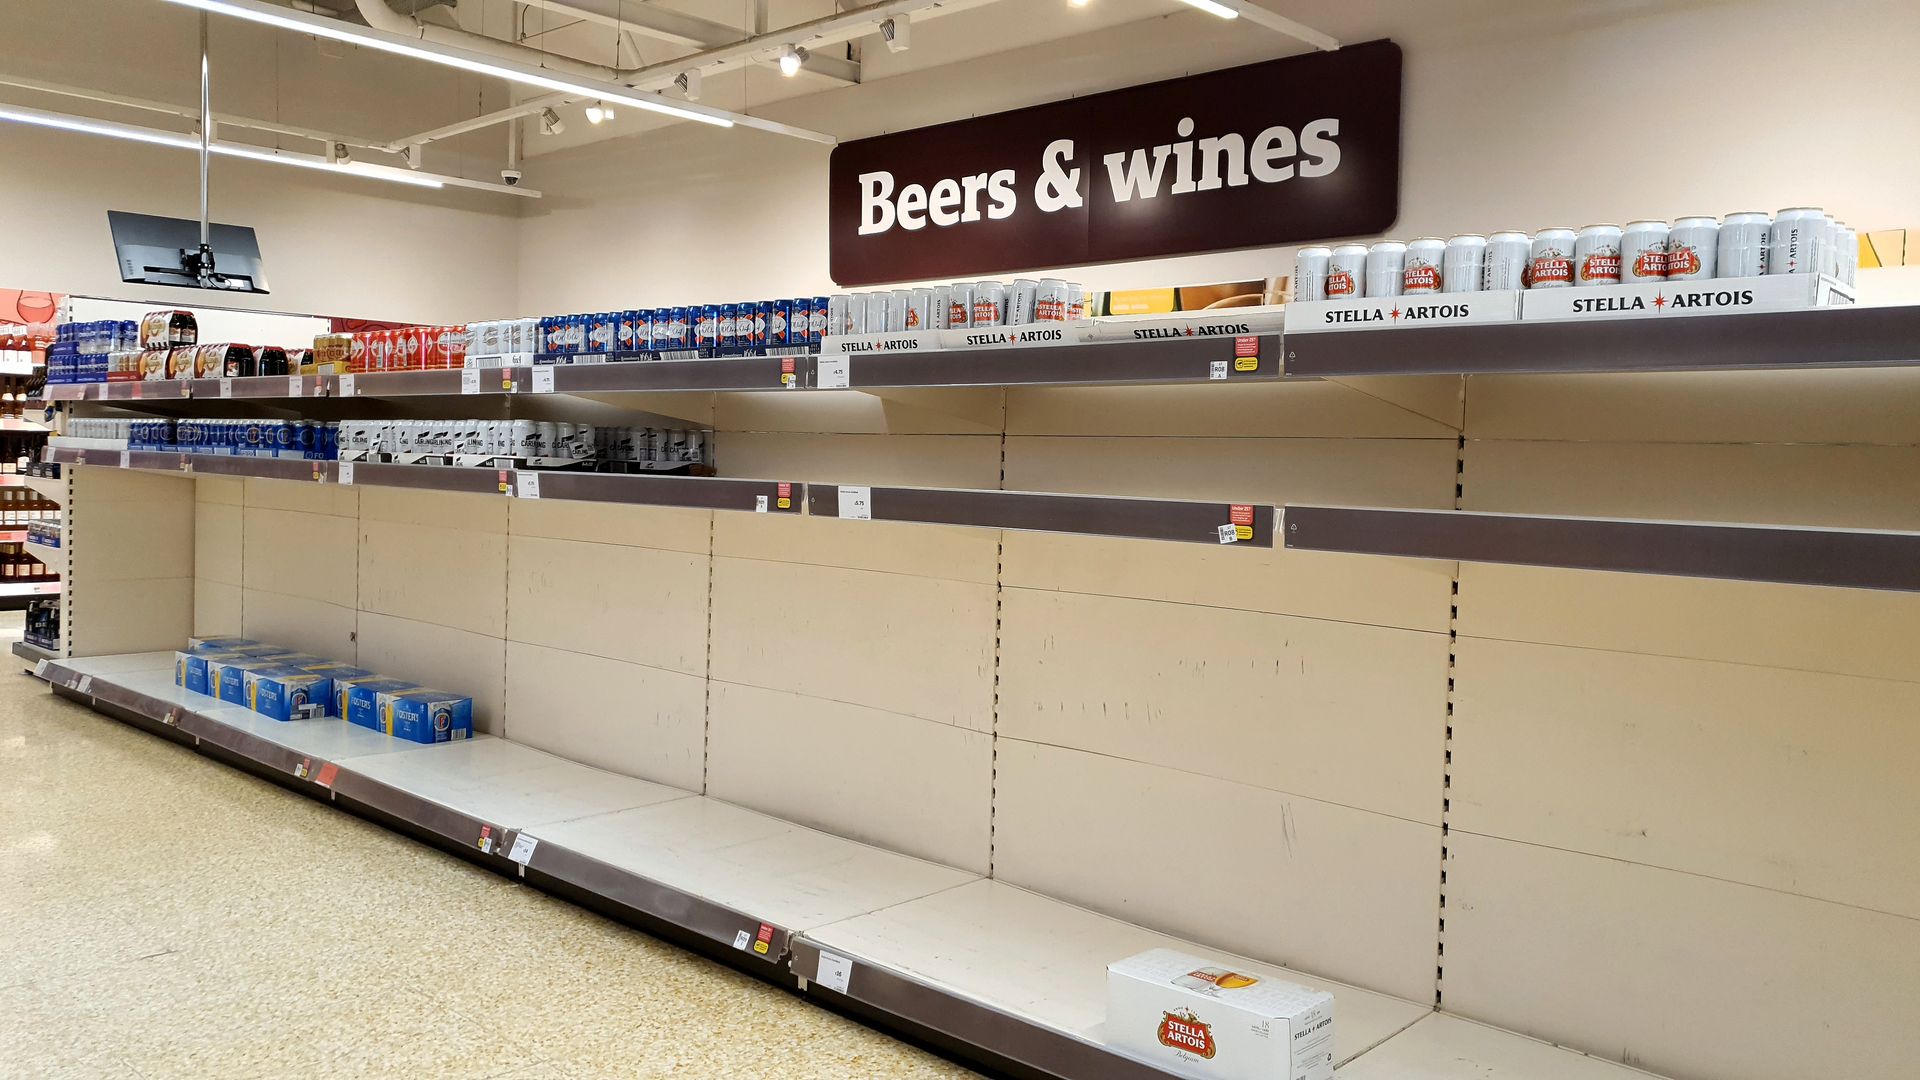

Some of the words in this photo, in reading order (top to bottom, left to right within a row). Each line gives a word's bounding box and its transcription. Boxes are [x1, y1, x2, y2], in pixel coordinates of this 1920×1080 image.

[857, 170, 1016, 236] Beers
[1034, 139, 1083, 213] &
[1103, 116, 1341, 203] wines
[1790, 228, 1799, 259] ARTOIS
[1643, 255, 1667, 263] STEL
[1668, 252, 1690, 262] ELLA
[1535, 260, 1568, 270] STELLA
[1589, 265, 1620, 275] ARTOI
[1643, 263, 1667, 271] ARTO
[1668, 260, 1690, 270] TOIS
[1405, 269, 1434, 278] STELLA
[1535, 268, 1569, 277] ARTOIS
[1328, 274, 1347, 283] ELLA
[1328, 281, 1347, 290] TOIS
[1573, 297, 1645, 312] STELLA
[1671, 290, 1754, 308] ARTOIS
[1325, 308, 1384, 323] STELLA
[1404, 304, 1469, 319] ARTOIS
[1134, 328, 1182, 339] STELLA
[1198, 323, 1250, 336] ARTOIS
[966, 333, 1006, 346] STELLA
[1020, 330, 1062, 343] ARTOIS
[841, 342, 873, 352] STELLA
[883, 339, 918, 350] ARTOIS
[1168, 1020, 1205, 1040] STELLA
[1294, 1028, 1312, 1040] STELLA
[1316, 1016, 1332, 1030] ARTOIS
[1167, 1031, 1206, 1050] ARTOIS
